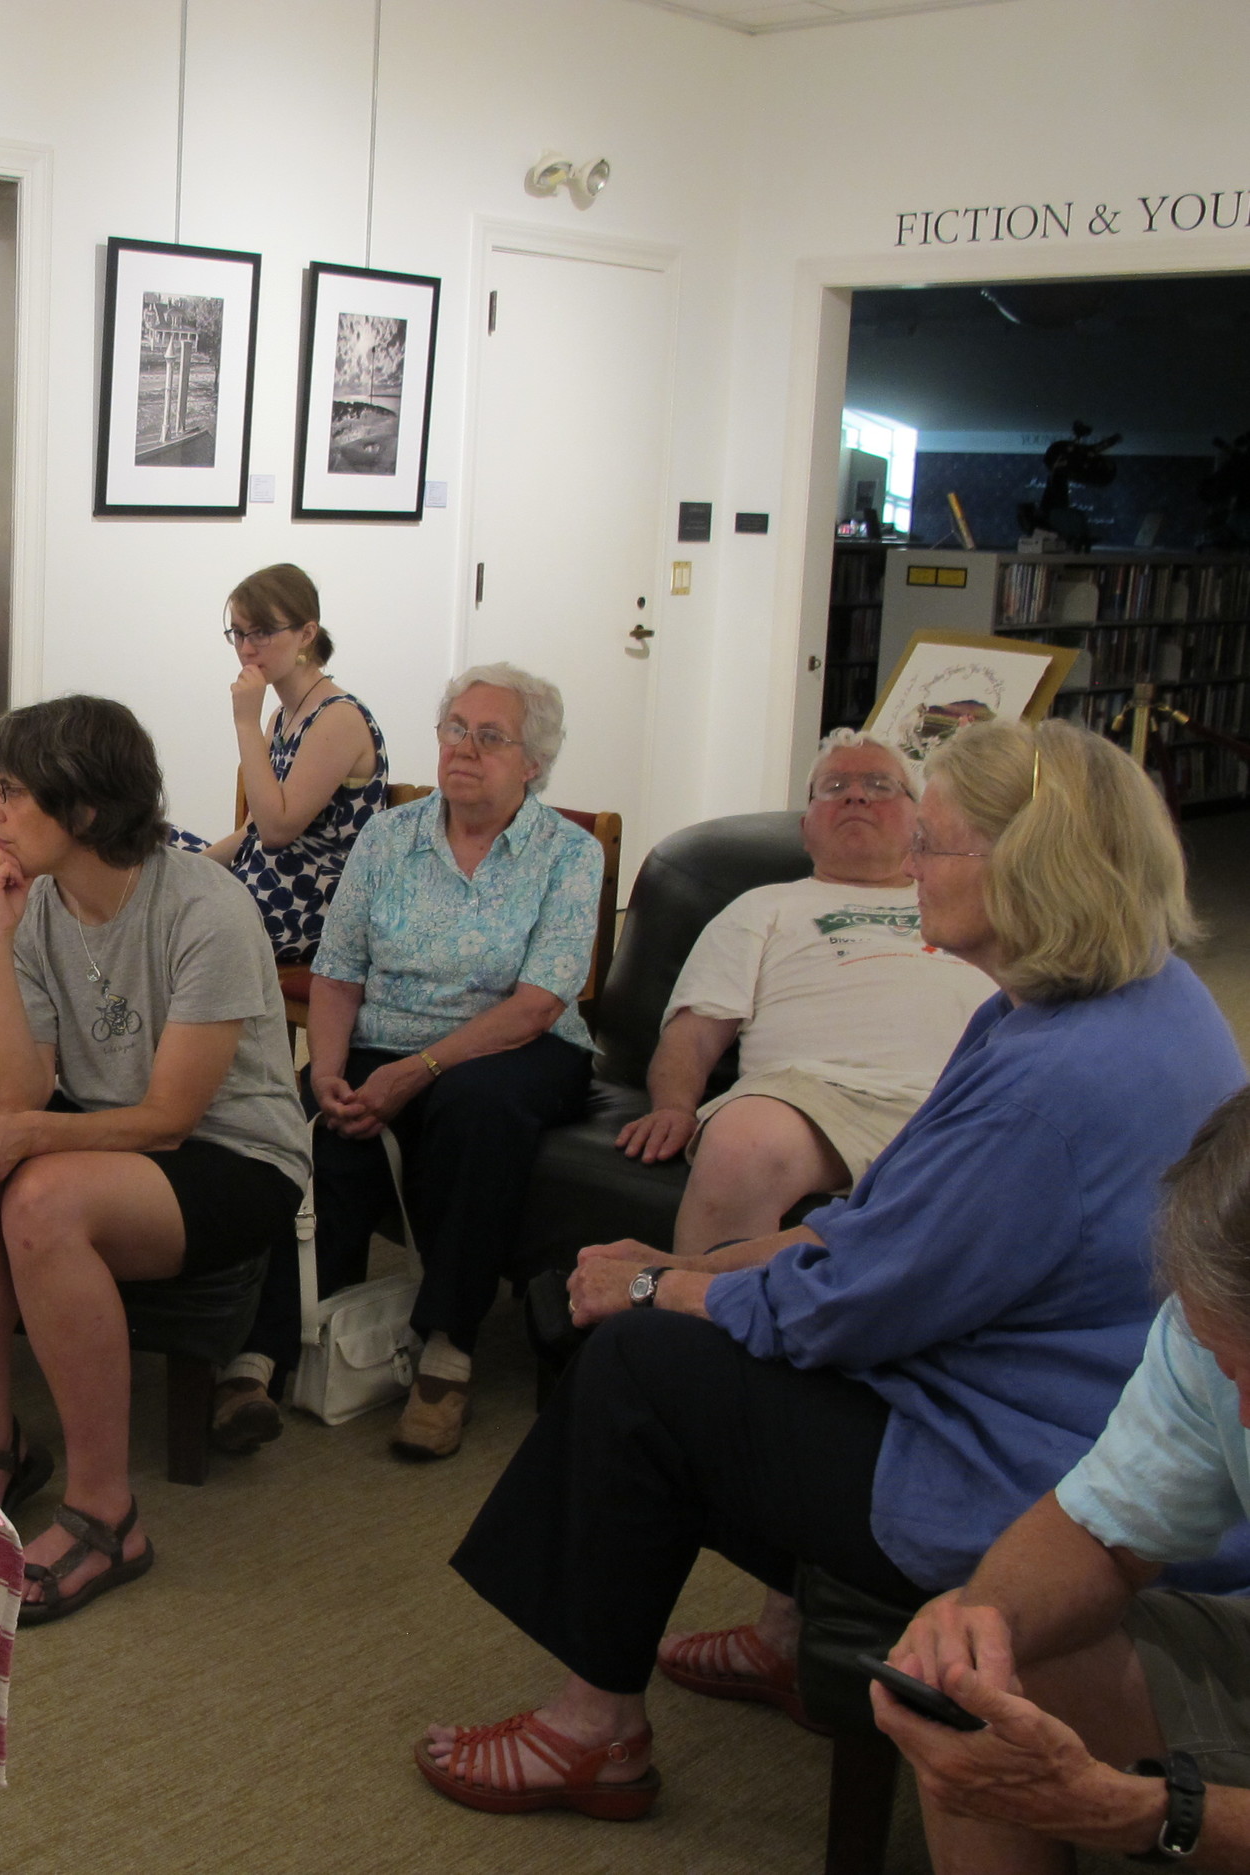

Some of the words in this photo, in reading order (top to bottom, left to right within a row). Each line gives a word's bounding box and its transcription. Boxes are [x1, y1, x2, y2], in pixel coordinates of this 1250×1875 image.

[894, 202, 1074, 247] FICTION
[1088, 203, 1121, 235] &
[1137, 190, 1250, 233] YOU
